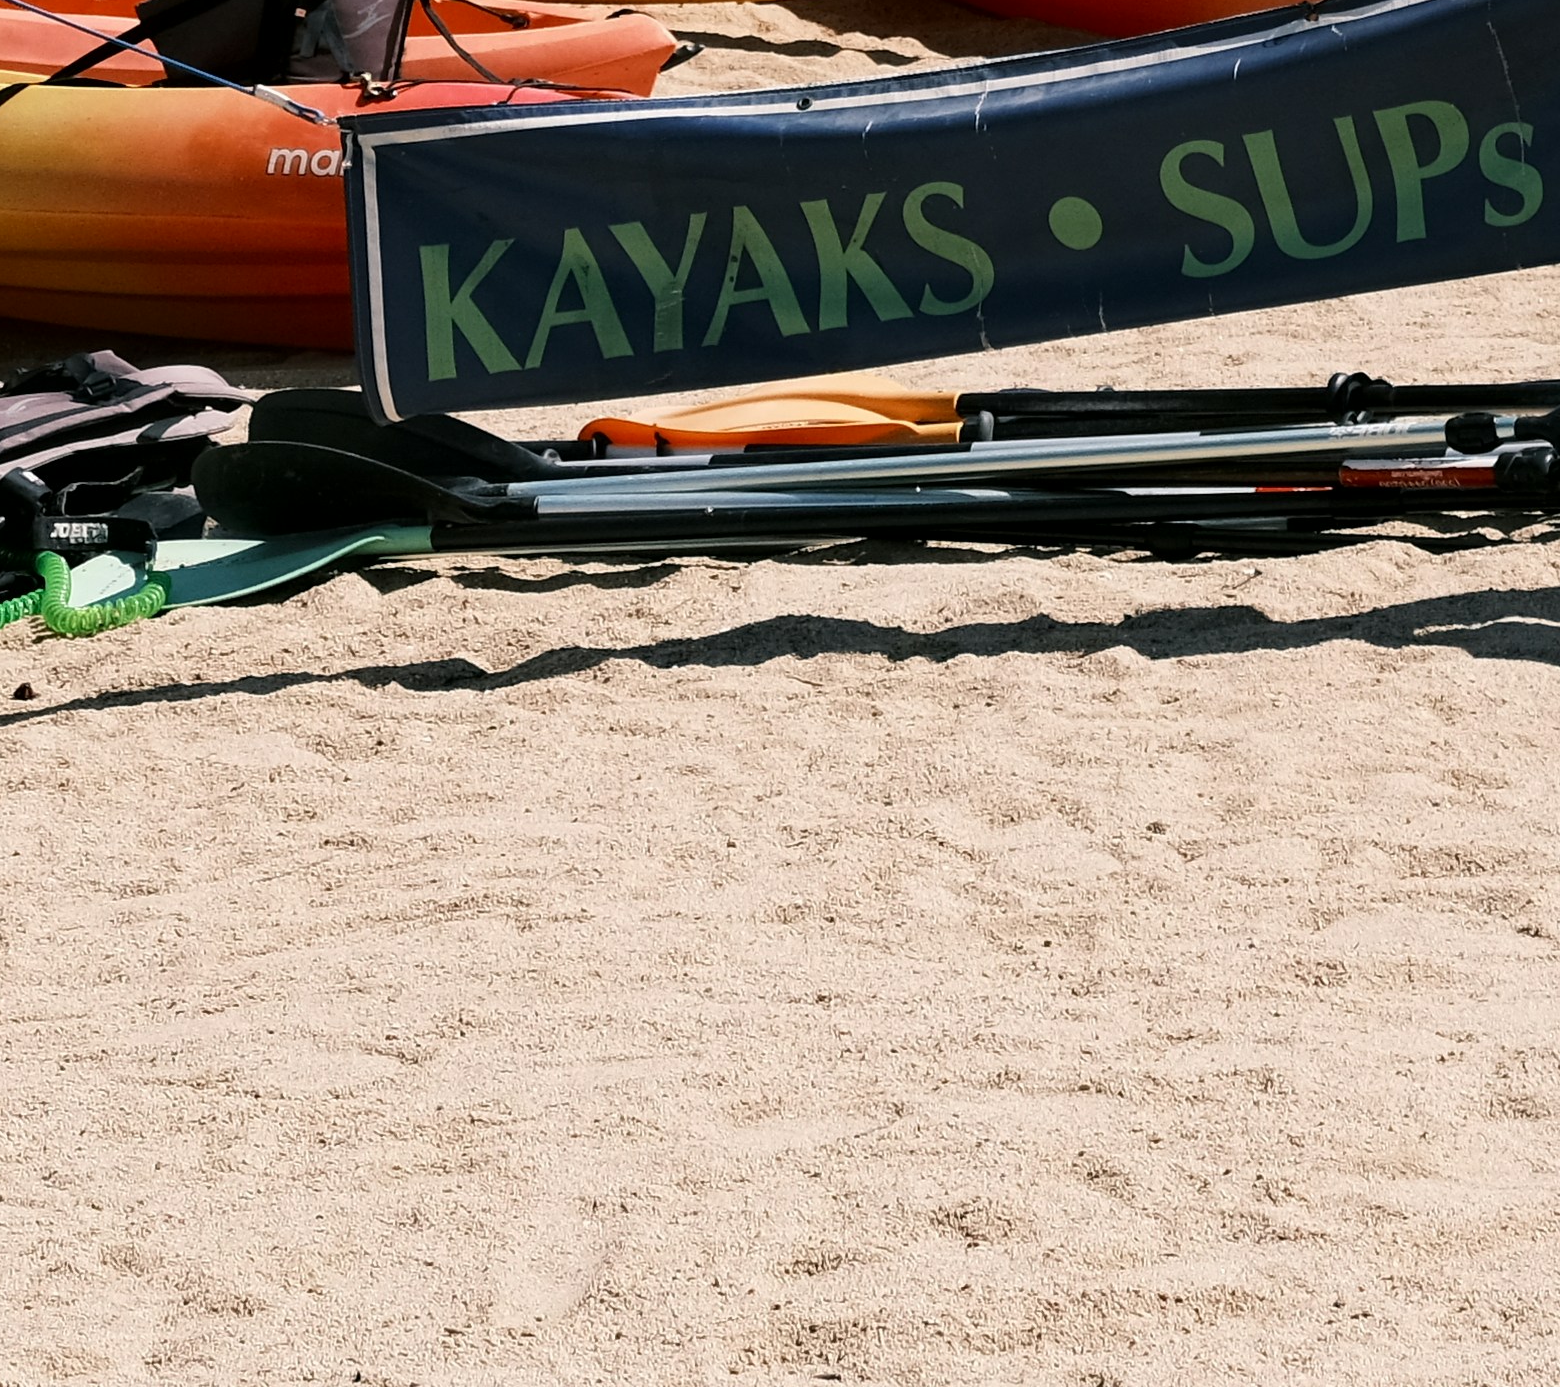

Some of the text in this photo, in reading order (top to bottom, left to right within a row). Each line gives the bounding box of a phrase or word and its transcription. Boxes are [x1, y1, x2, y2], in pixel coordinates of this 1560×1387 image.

[266, 147, 344, 177] ma
[419, 181, 995, 381] KAYAKS
[1158, 99, 1545, 281] SUPs
